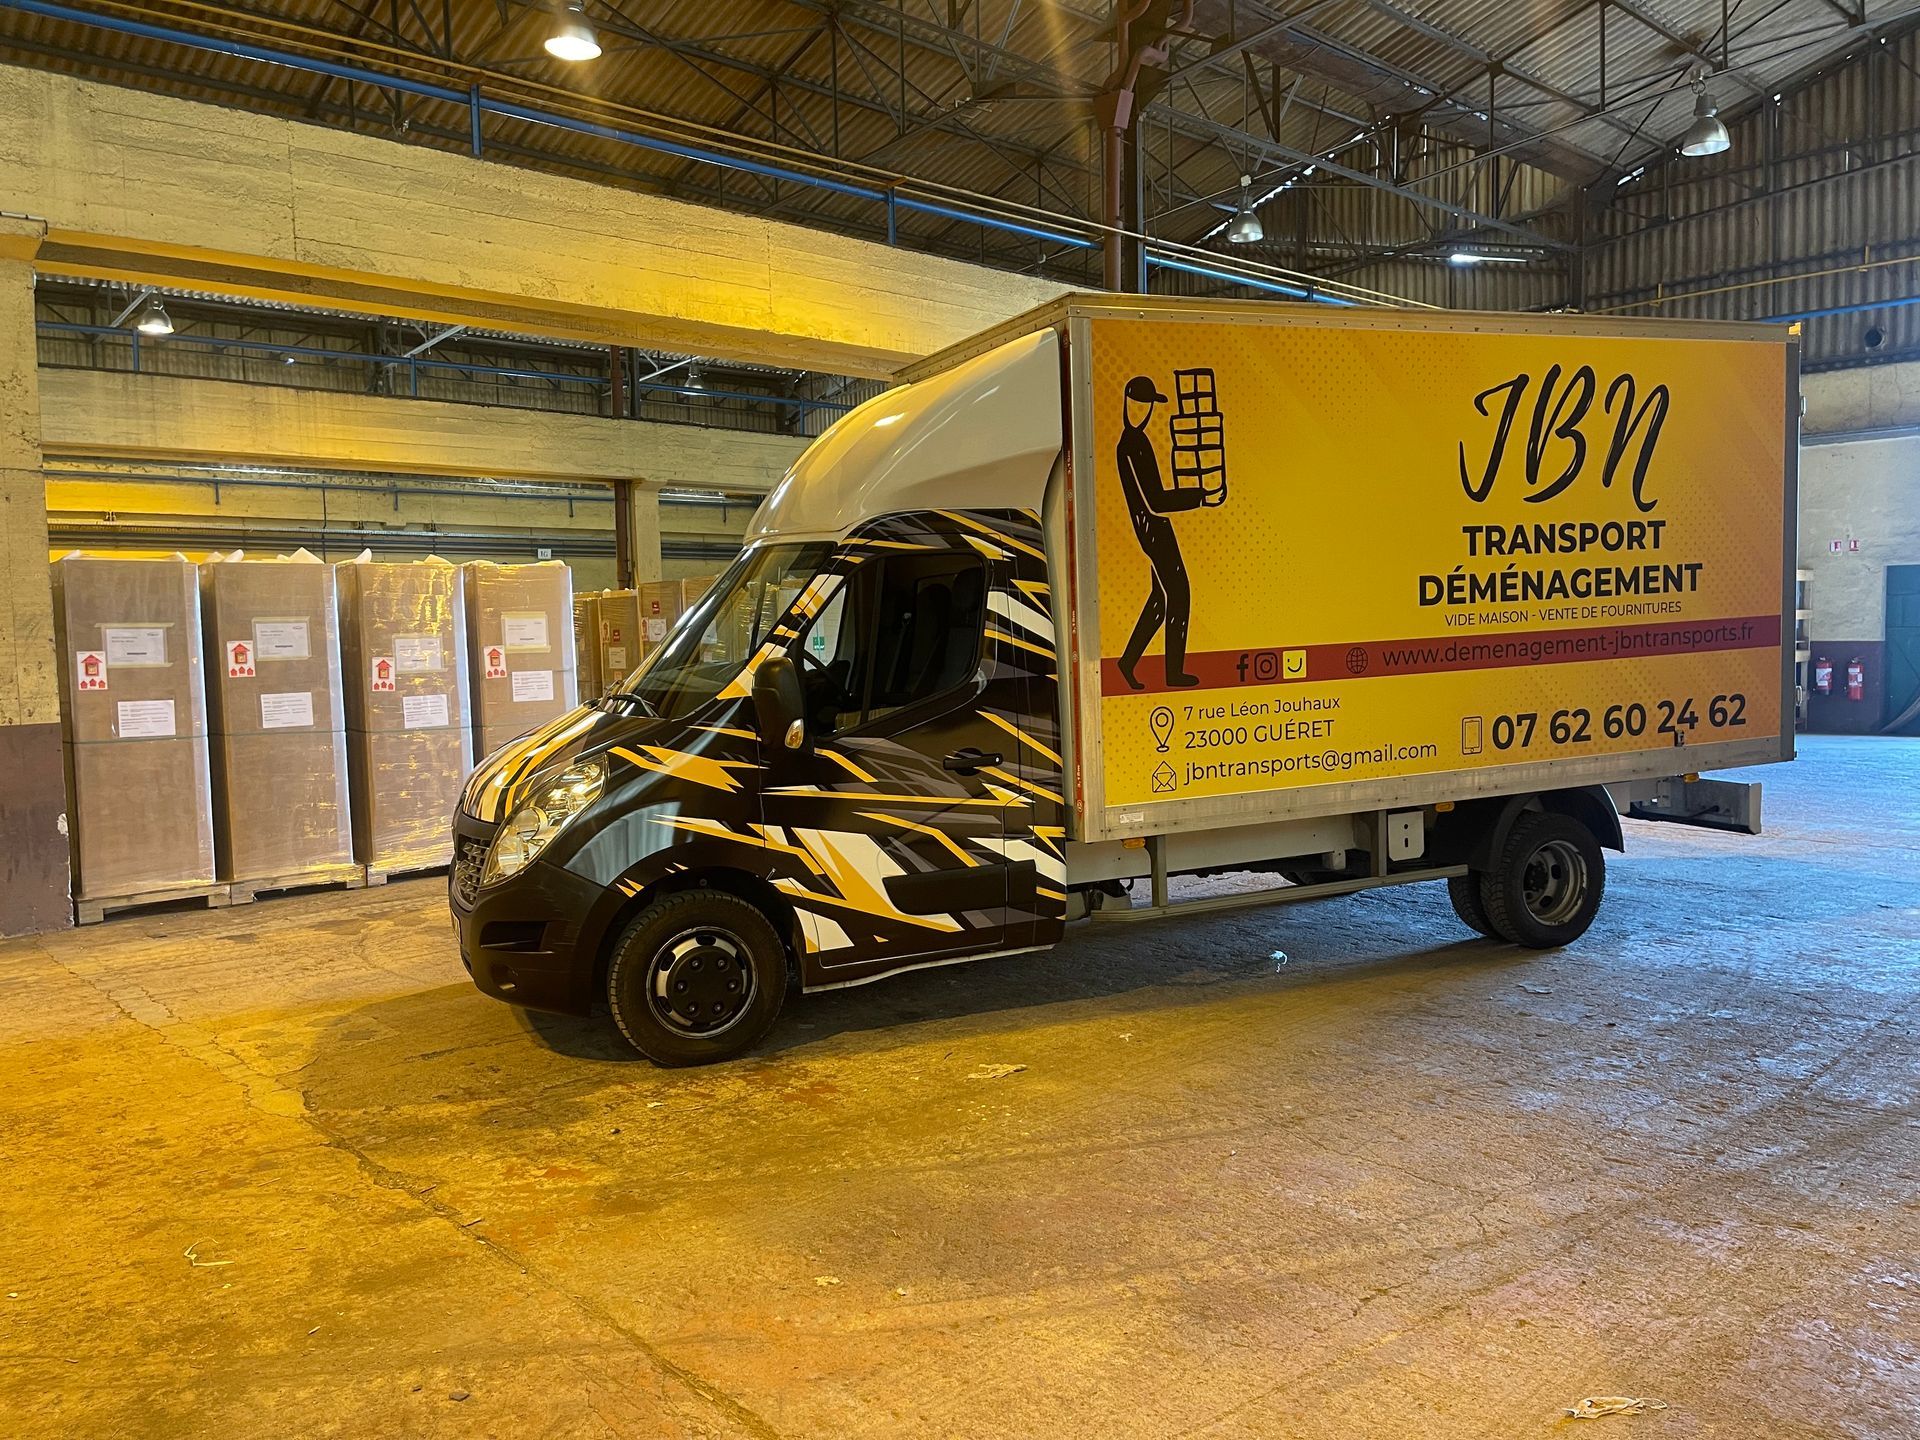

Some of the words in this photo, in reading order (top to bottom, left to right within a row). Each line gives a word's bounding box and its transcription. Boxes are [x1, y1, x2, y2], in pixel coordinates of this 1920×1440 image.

[1459, 364, 1670, 513] JBN
[1462, 520, 1666, 557] TRANSPORT
[1419, 562, 1703, 606] DÉMÉNAGEMENT
[1445, 613, 1475, 627] VIDE
[1478, 610, 1529, 625] MAISON
[1538, 607, 1578, 621] VENTE
[1581, 606, 1598, 619] DE
[1601, 601, 1682, 617] FOURNITURES
[1382, 622, 1754, 666] www.demenagement-jbntransports.fr
[1184, 706, 1193, 721] 7
[1198, 705, 1225, 720] rue
[1230, 701, 1269, 718] Léon
[1274, 697, 1341, 714] Jouhaux
[1492, 713, 1537, 750] 07
[1549, 708, 1591, 744] 62
[1603, 703, 1647, 738] 60
[1657, 698, 1698, 734] 24
[1708, 693, 1747, 727] 62
[1184, 727, 1247, 749] 23000
[1254, 719, 1335, 743] GUÉRET
[1184, 742, 1437, 786] jbntransports@gmail.com
